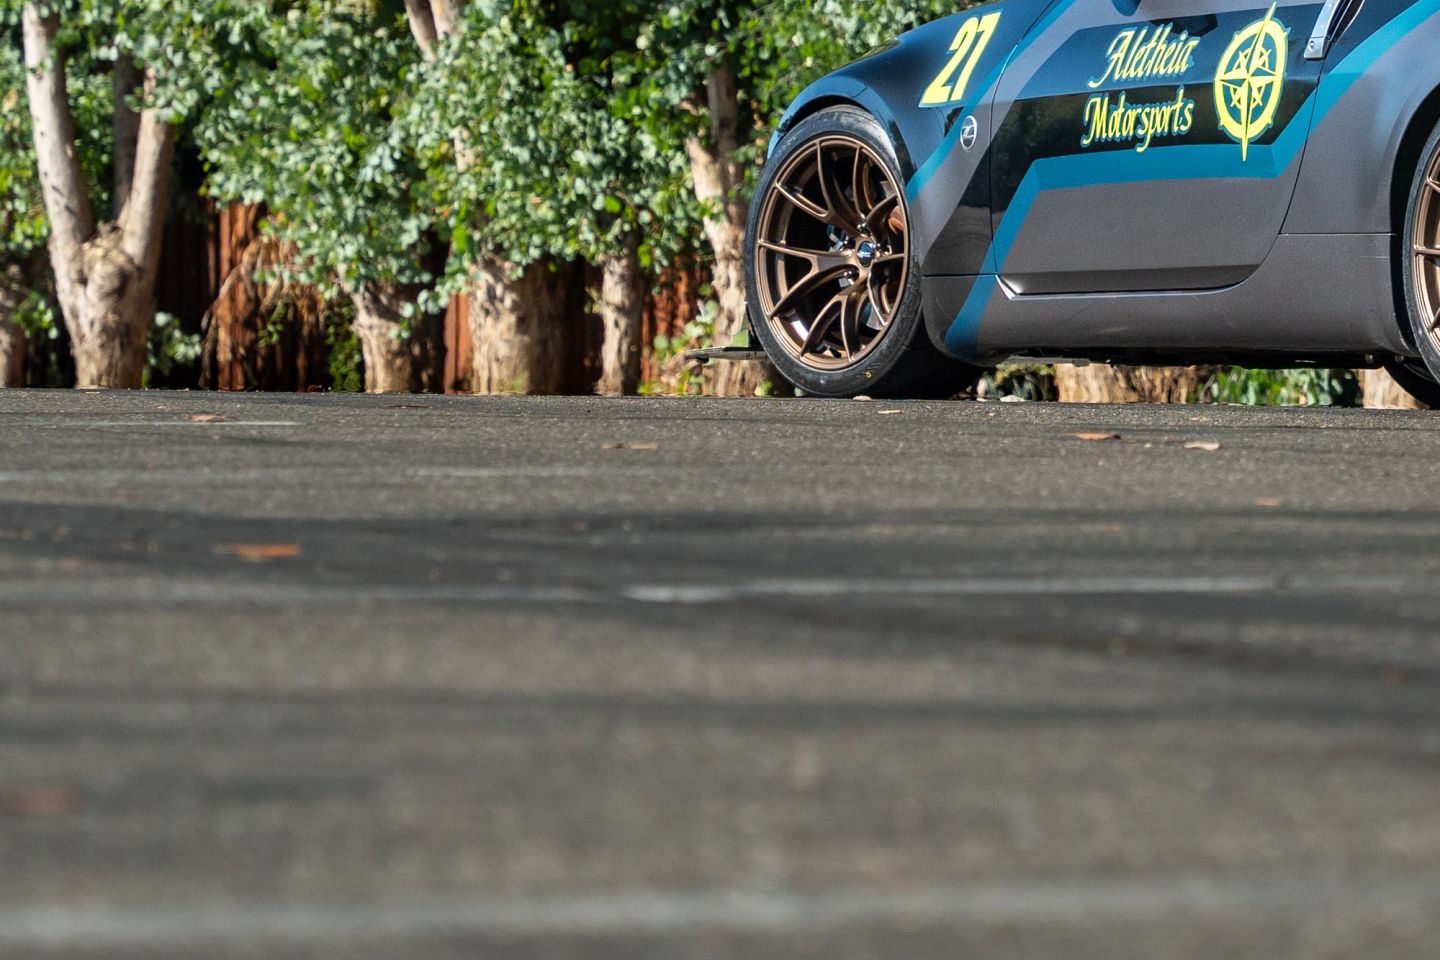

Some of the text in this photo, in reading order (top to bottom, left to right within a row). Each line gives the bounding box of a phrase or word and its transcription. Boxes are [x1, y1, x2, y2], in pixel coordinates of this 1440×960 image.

[920, 10, 1003, 105] 27
[1088, 24, 1198, 88] Aletheia
[1082, 88, 1194, 154] Motorsports
